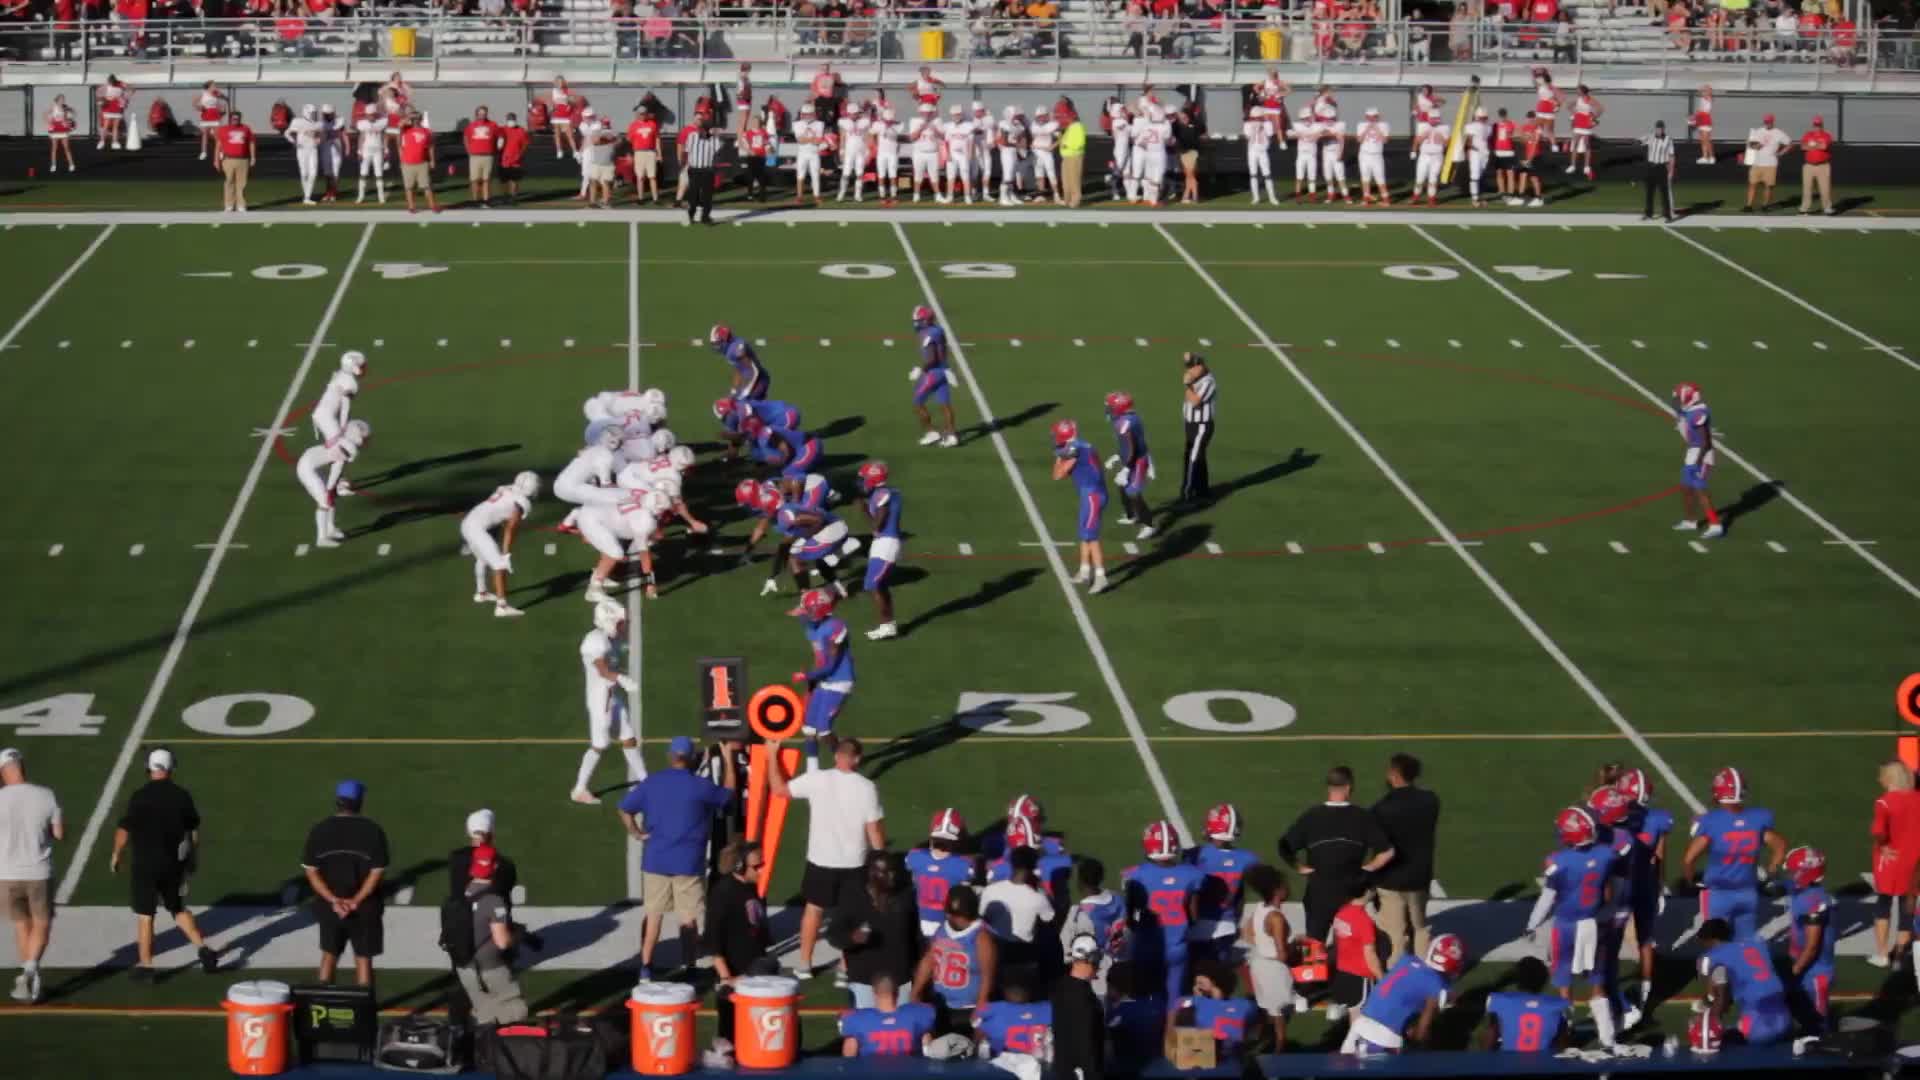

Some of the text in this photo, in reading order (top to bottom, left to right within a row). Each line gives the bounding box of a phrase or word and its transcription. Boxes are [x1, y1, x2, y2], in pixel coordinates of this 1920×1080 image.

[710, 666, 731, 709] 1
[1722, 830, 1759, 864] 72
[243, 1017, 264, 1038] G
[654, 1016, 673, 1037] G
[761, 1010, 783, 1031] G
[1515, 1012, 1543, 1052] 8
